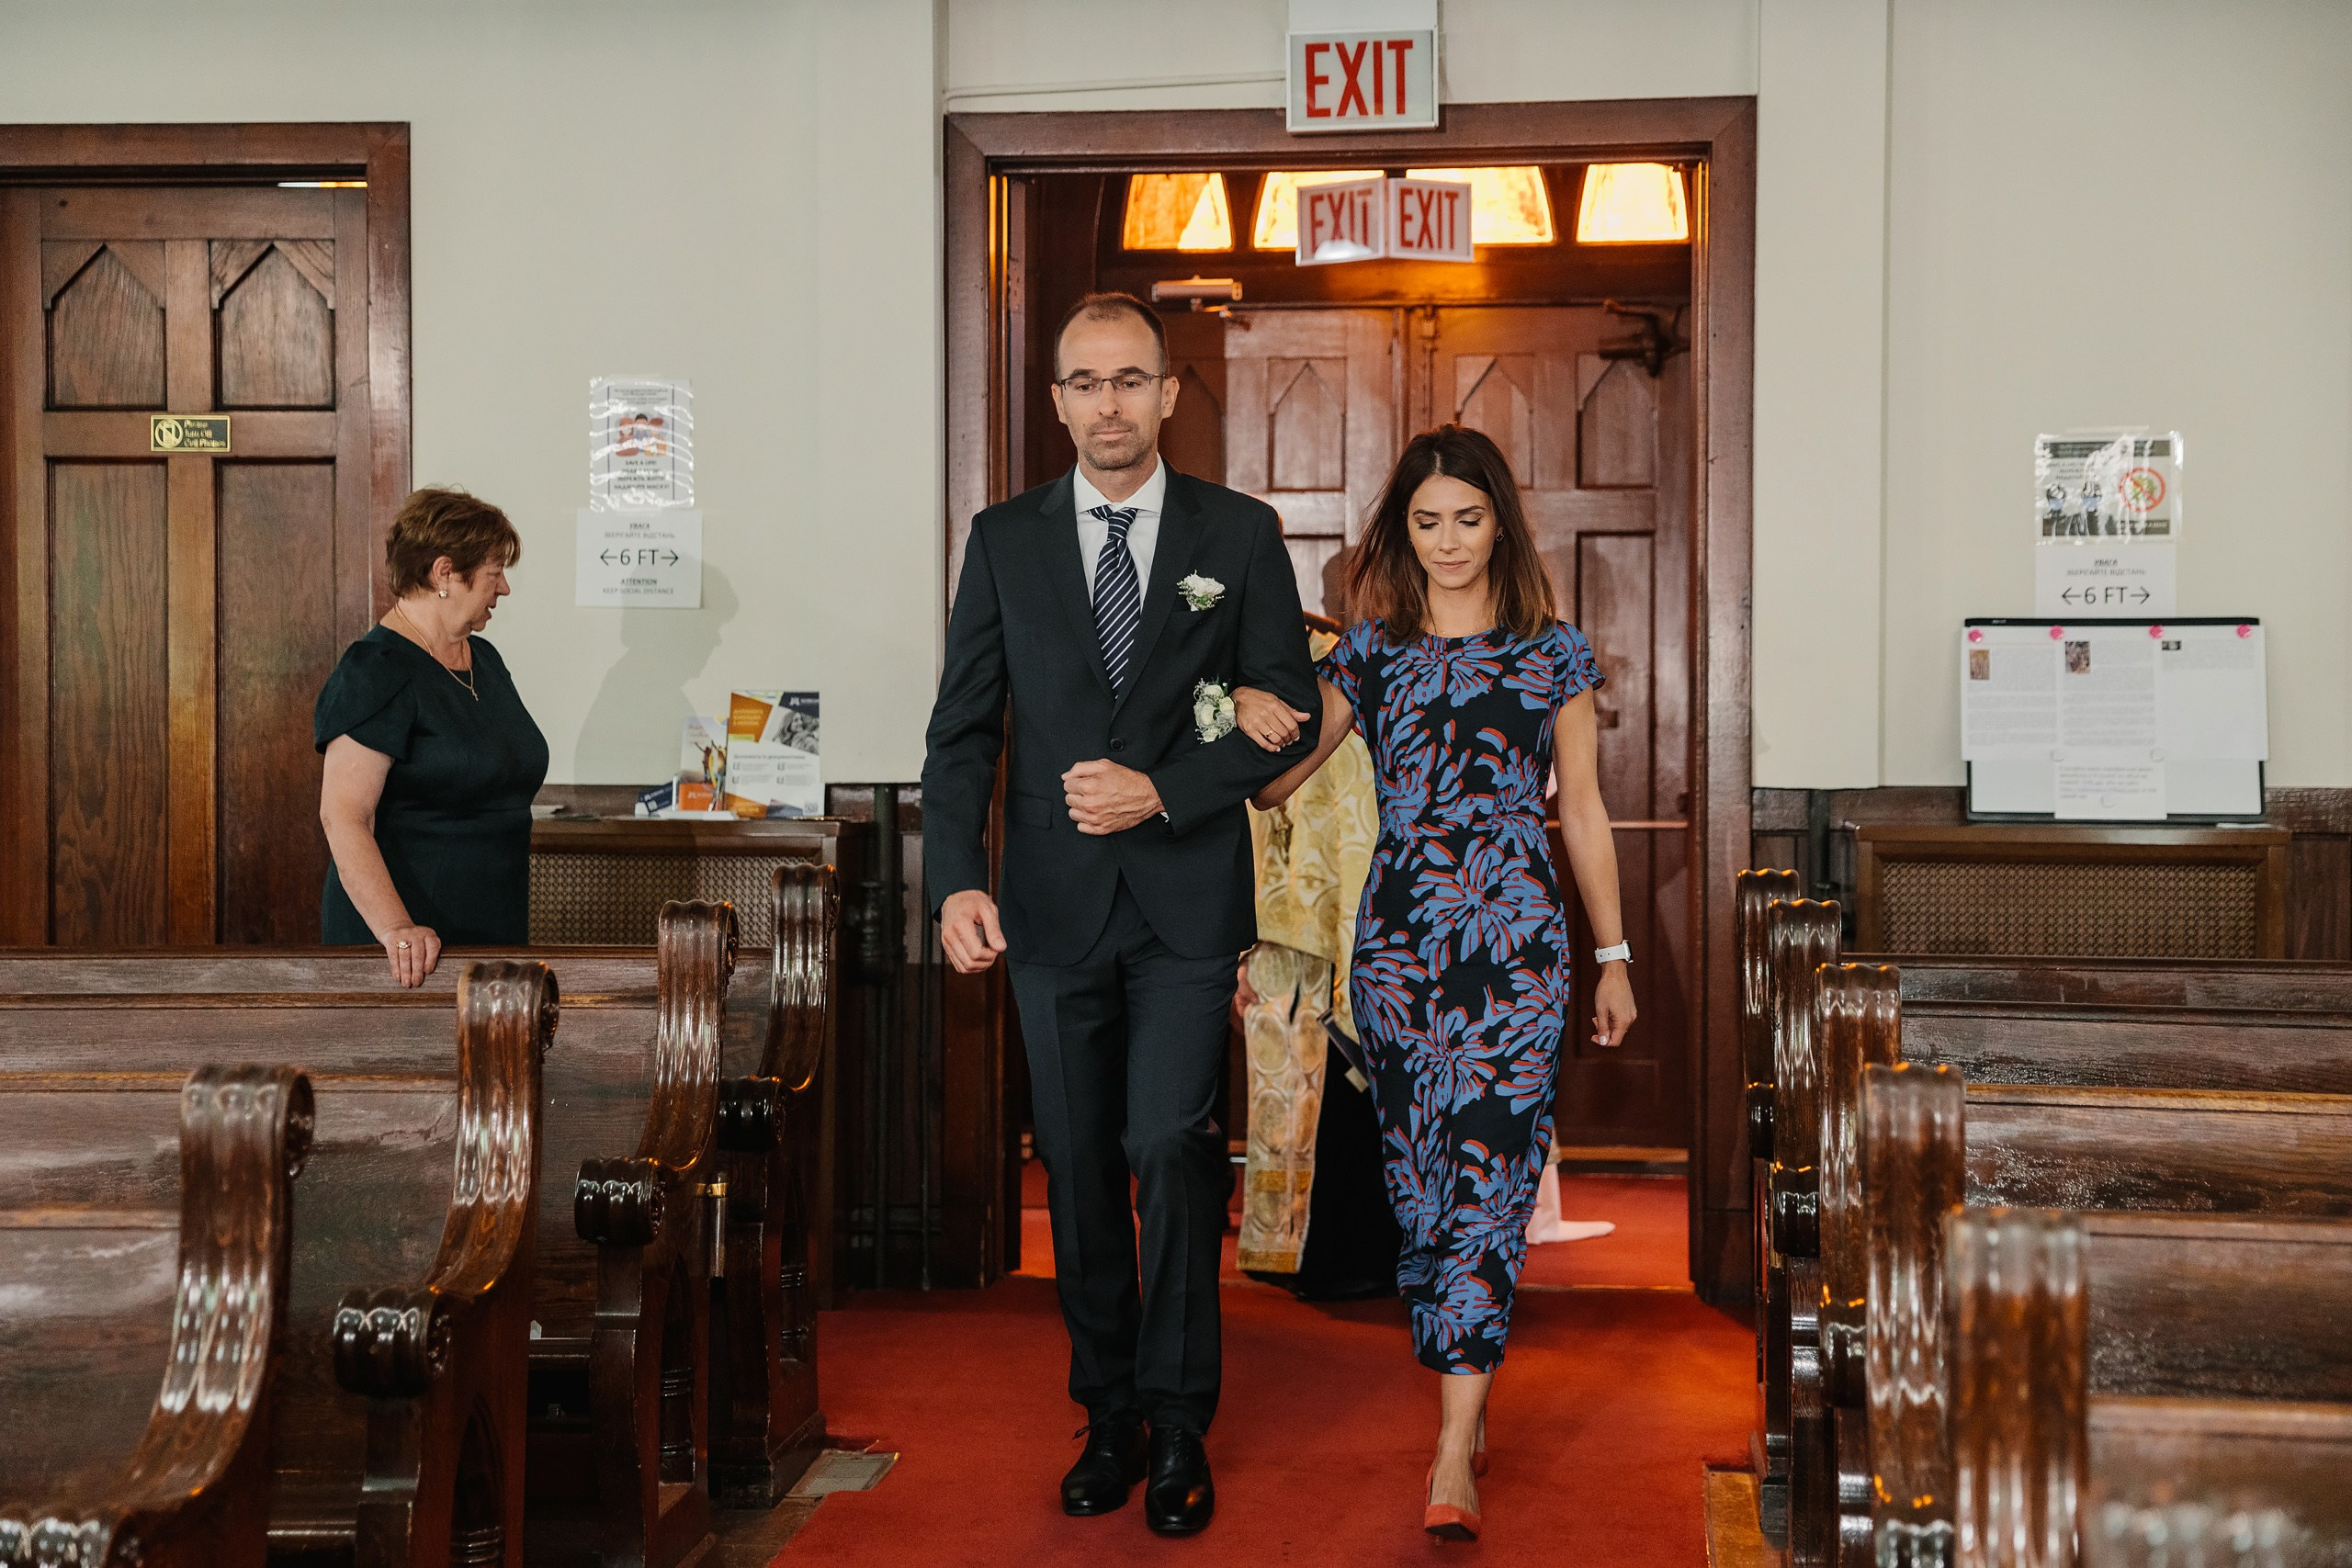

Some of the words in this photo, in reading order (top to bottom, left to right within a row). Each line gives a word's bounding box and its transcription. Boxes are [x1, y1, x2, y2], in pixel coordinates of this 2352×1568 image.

[1306, 39, 1413, 118] EXIT
[1310, 188, 1372, 254] EXIT
[1399, 187, 1458, 250] EXIT
[620, 548, 630, 566] 6
[639, 548, 660, 565] FT
[2085, 586, 2097, 604] 6
[2104, 586, 2128, 604] FT
